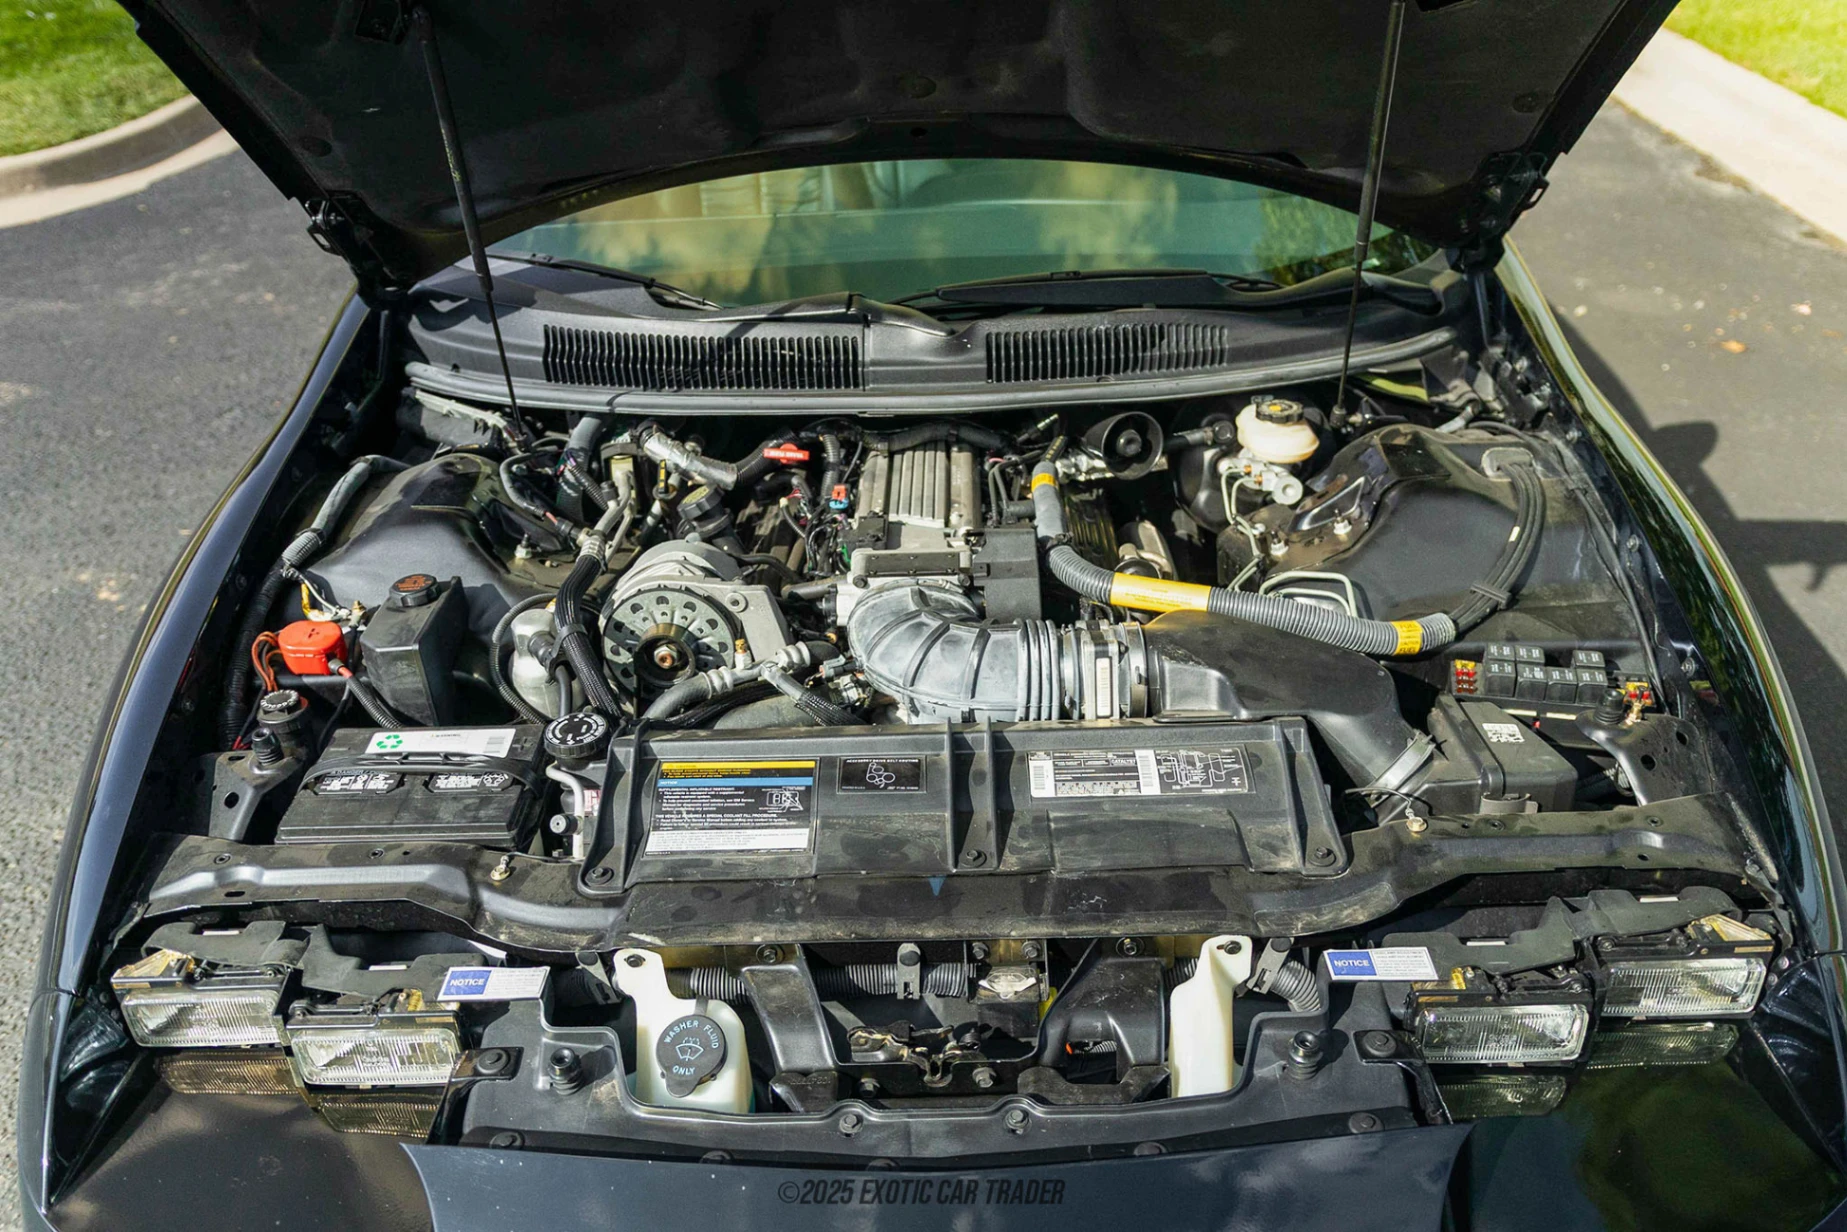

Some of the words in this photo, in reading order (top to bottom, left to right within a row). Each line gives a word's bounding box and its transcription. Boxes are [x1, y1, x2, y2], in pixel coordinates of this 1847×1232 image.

[1334, 959, 1370, 967] NOTICE
[449, 978, 485, 987] NOTICE
[664, 1020, 699, 1043] WASHER
[703, 1024, 719, 1049] FLUID
[672, 1065, 696, 1075] ONLY
